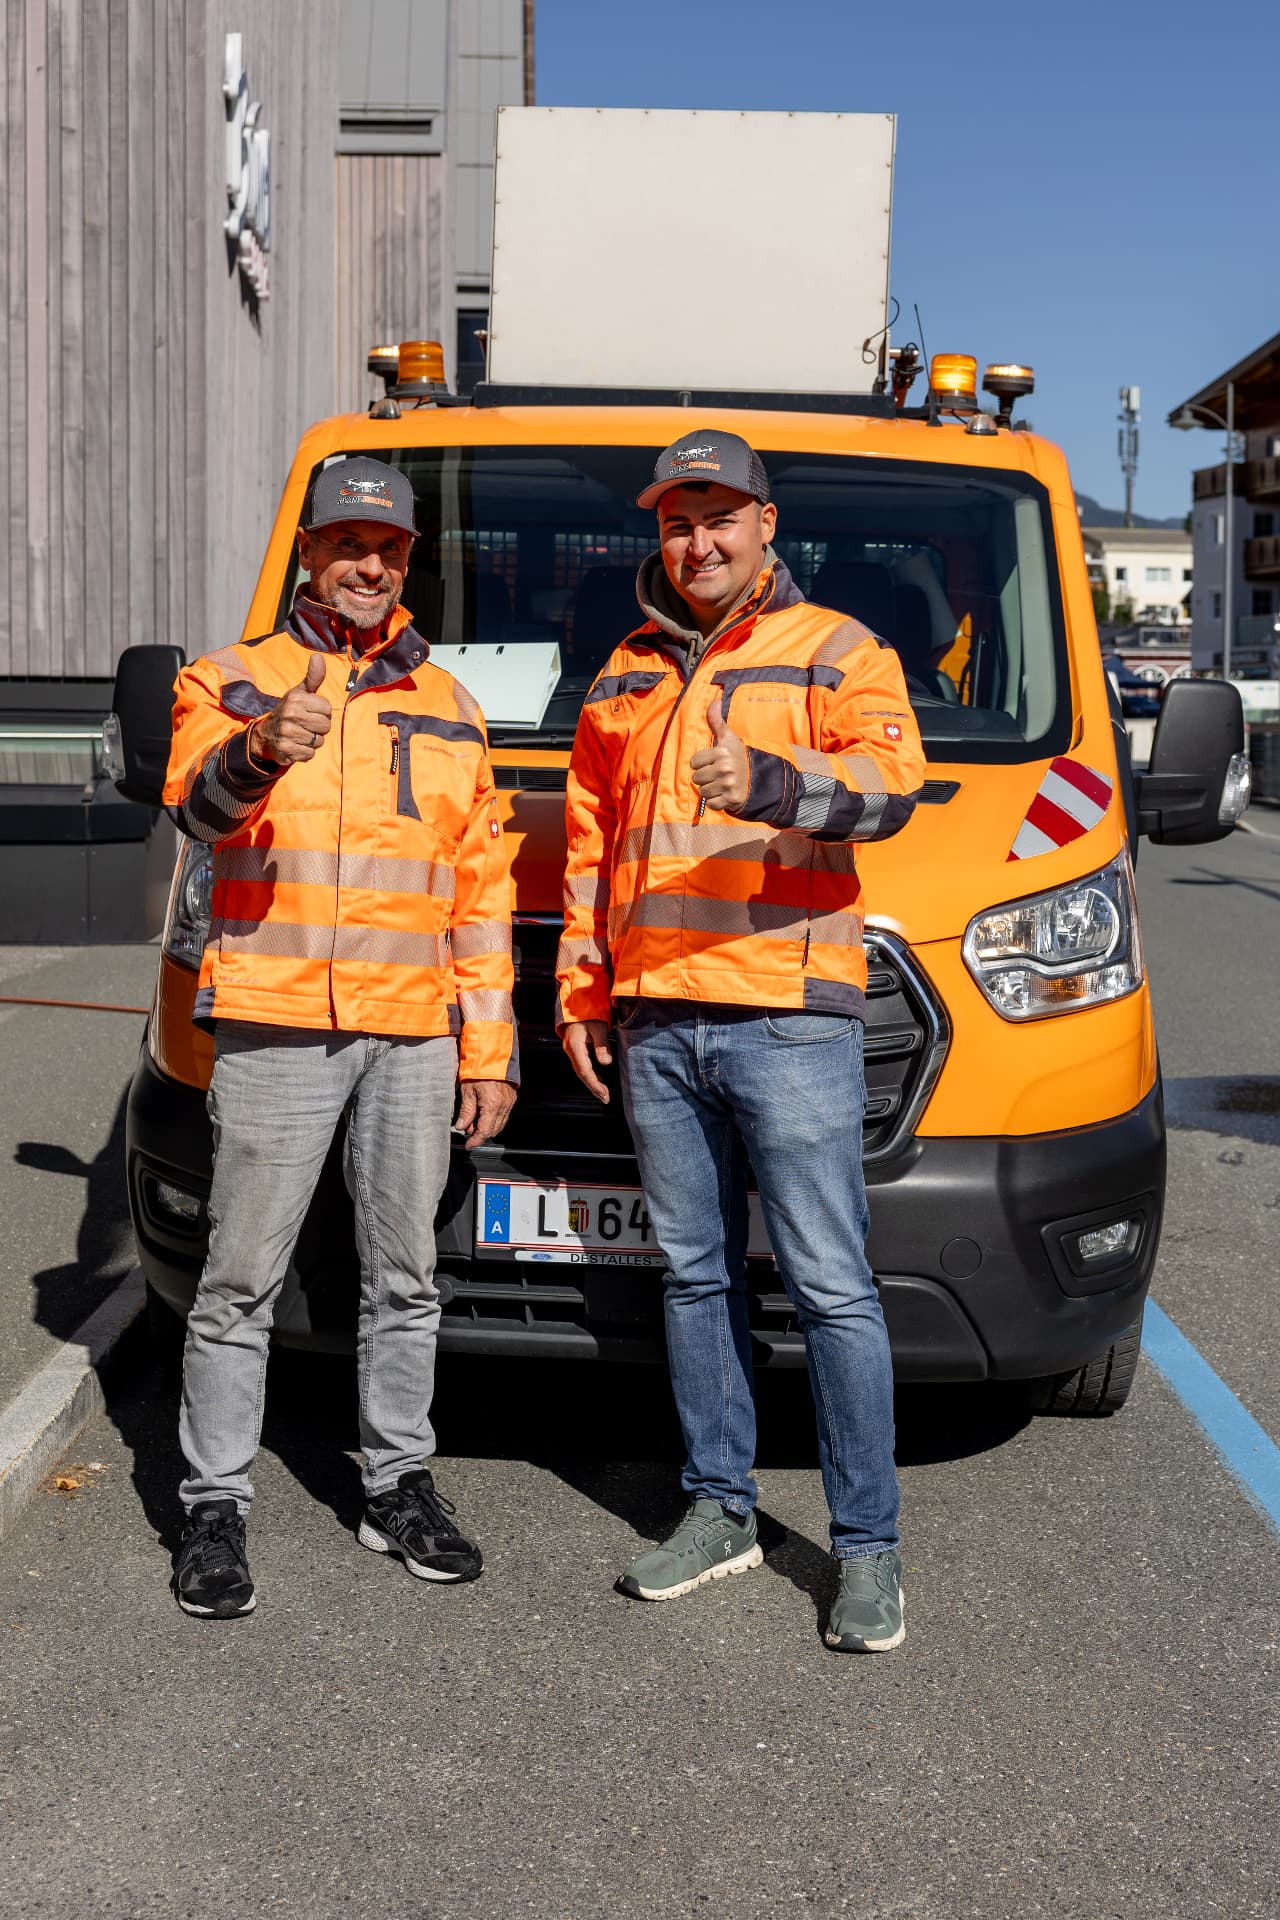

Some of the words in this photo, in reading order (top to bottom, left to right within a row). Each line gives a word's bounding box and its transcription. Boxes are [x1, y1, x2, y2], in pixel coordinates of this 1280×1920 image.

[538, 1195, 558, 1237] L
[491, 1221, 503, 1234] A
[570, 1253, 652, 1266] DESTALLES
